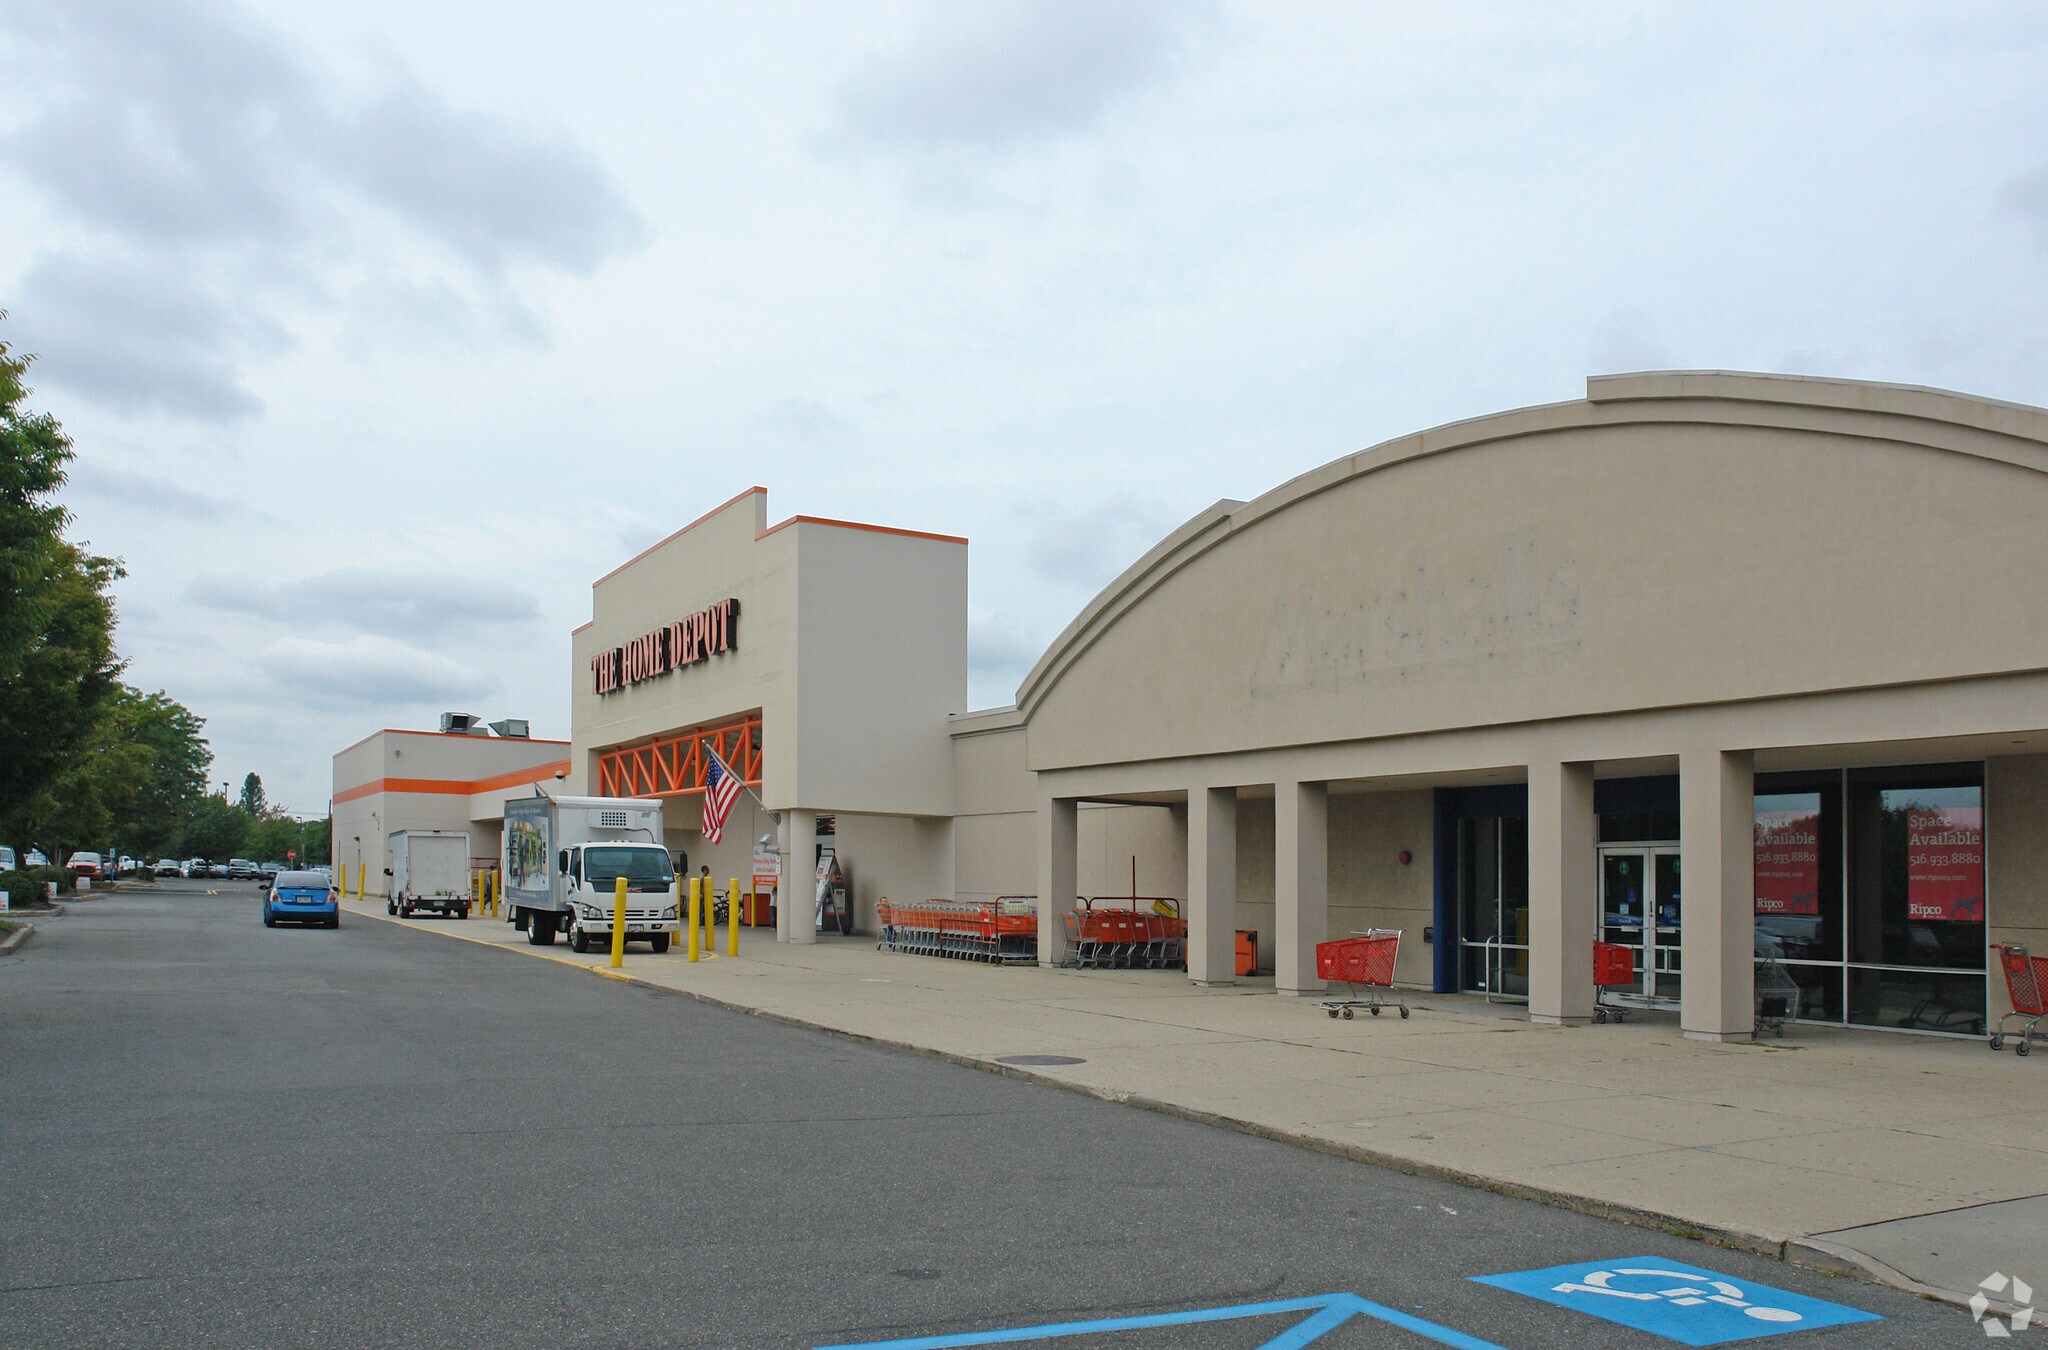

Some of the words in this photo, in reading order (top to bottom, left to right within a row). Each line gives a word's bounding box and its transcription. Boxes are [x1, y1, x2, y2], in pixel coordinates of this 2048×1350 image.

[591, 648, 619, 695] THE
[621, 628, 666, 686] HOME
[669, 598, 735, 670] DEPOT
[1757, 817, 1792, 830] Space
[1909, 815, 1952, 830] Space
[1756, 832, 1816, 845] Available
[1909, 832, 1980, 846] Available
[1757, 852, 1816, 865] 516.933.8880
[1909, 853, 1981, 867] 516.933.8880
[1757, 897, 1784, 912] Ripco
[1909, 902, 1942, 918] Ripco
